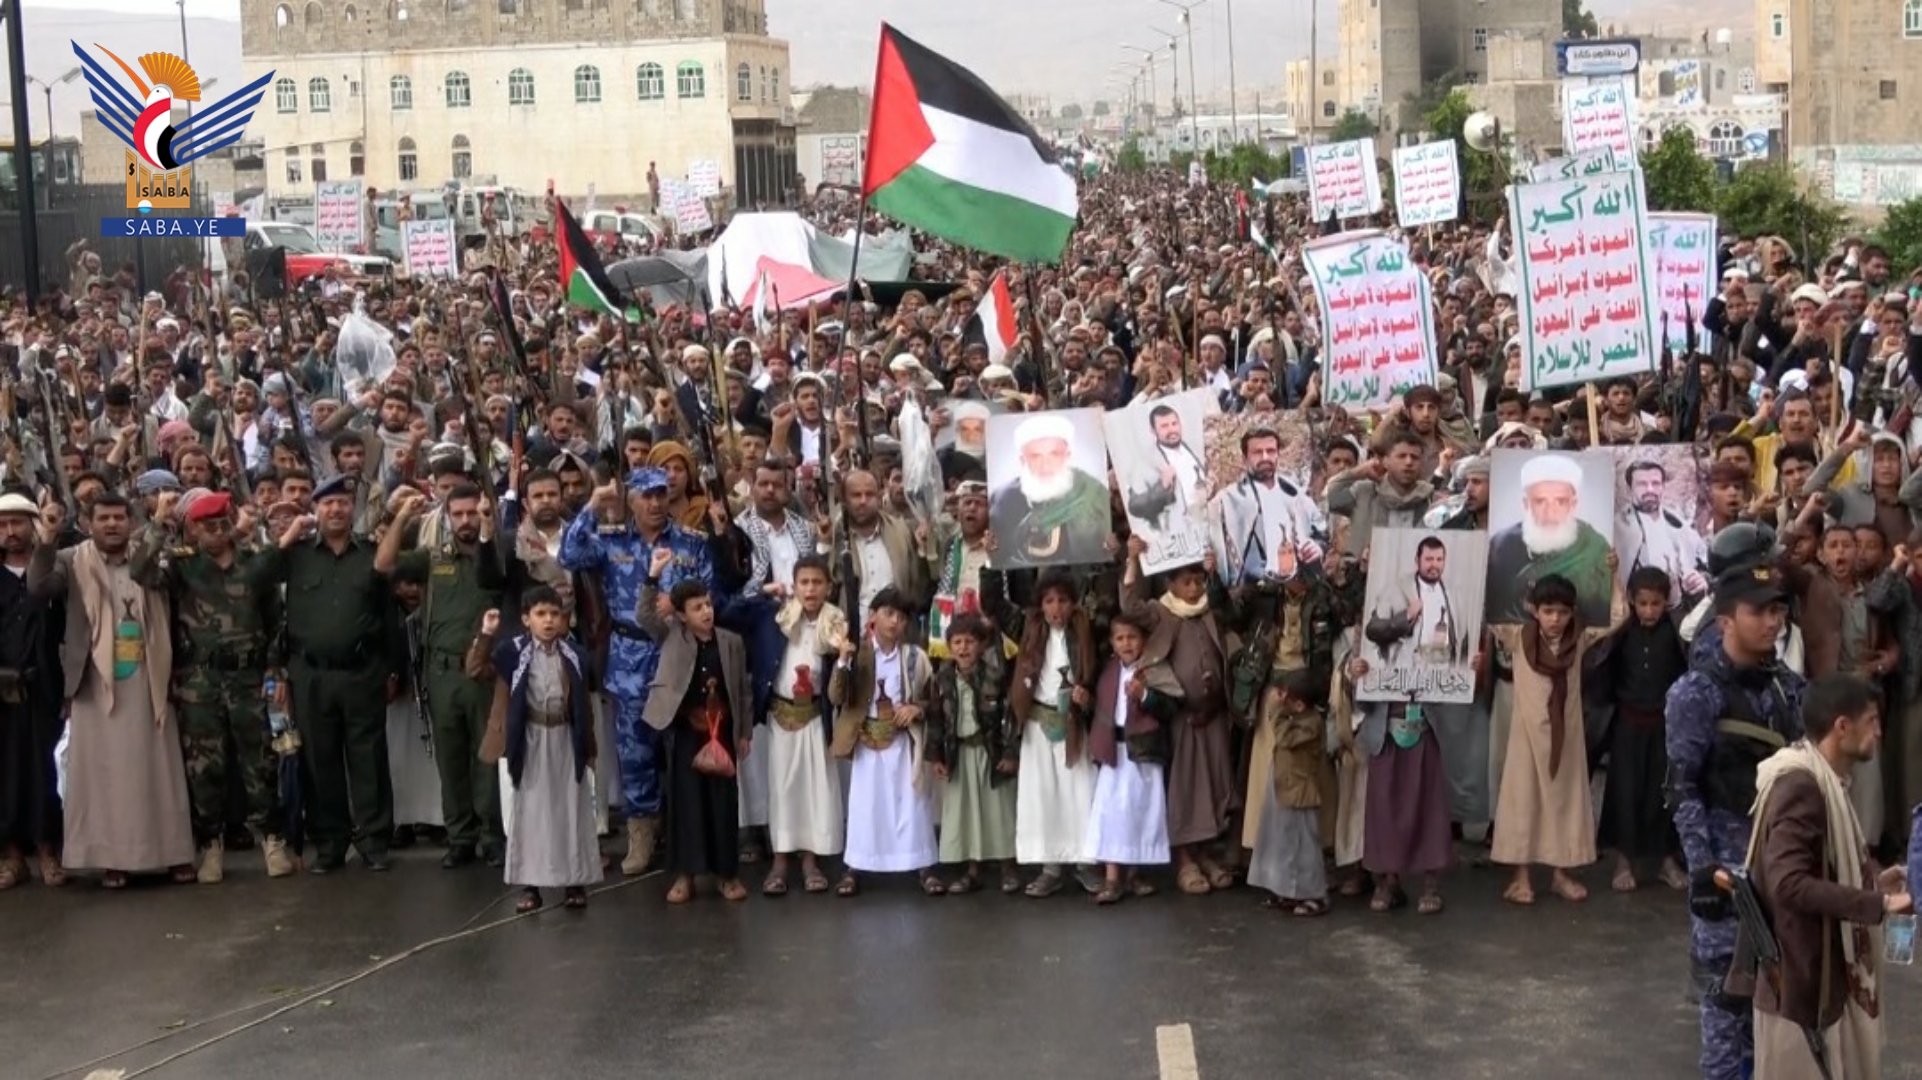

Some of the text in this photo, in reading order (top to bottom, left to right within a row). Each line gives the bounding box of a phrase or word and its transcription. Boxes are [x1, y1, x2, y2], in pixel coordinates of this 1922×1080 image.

[1527, 180, 1632, 234] الله أكبر
[1528, 228, 1634, 264] الموت لأمريكا
[1674, 225, 1706, 249] الله
[1326, 242, 1371, 286] أكبر
[1593, 262, 1638, 292] الموت
[1377, 280, 1417, 306] الموت
[1382, 311, 1421, 337] الموت
[1535, 296, 1641, 337] اللعنة على اليهود
[1332, 350, 1366, 376] اليهود
[1371, 347, 1391, 370] على
[1536, 338, 1591, 379] للإسلام
[1598, 329, 1646, 370] النصر
